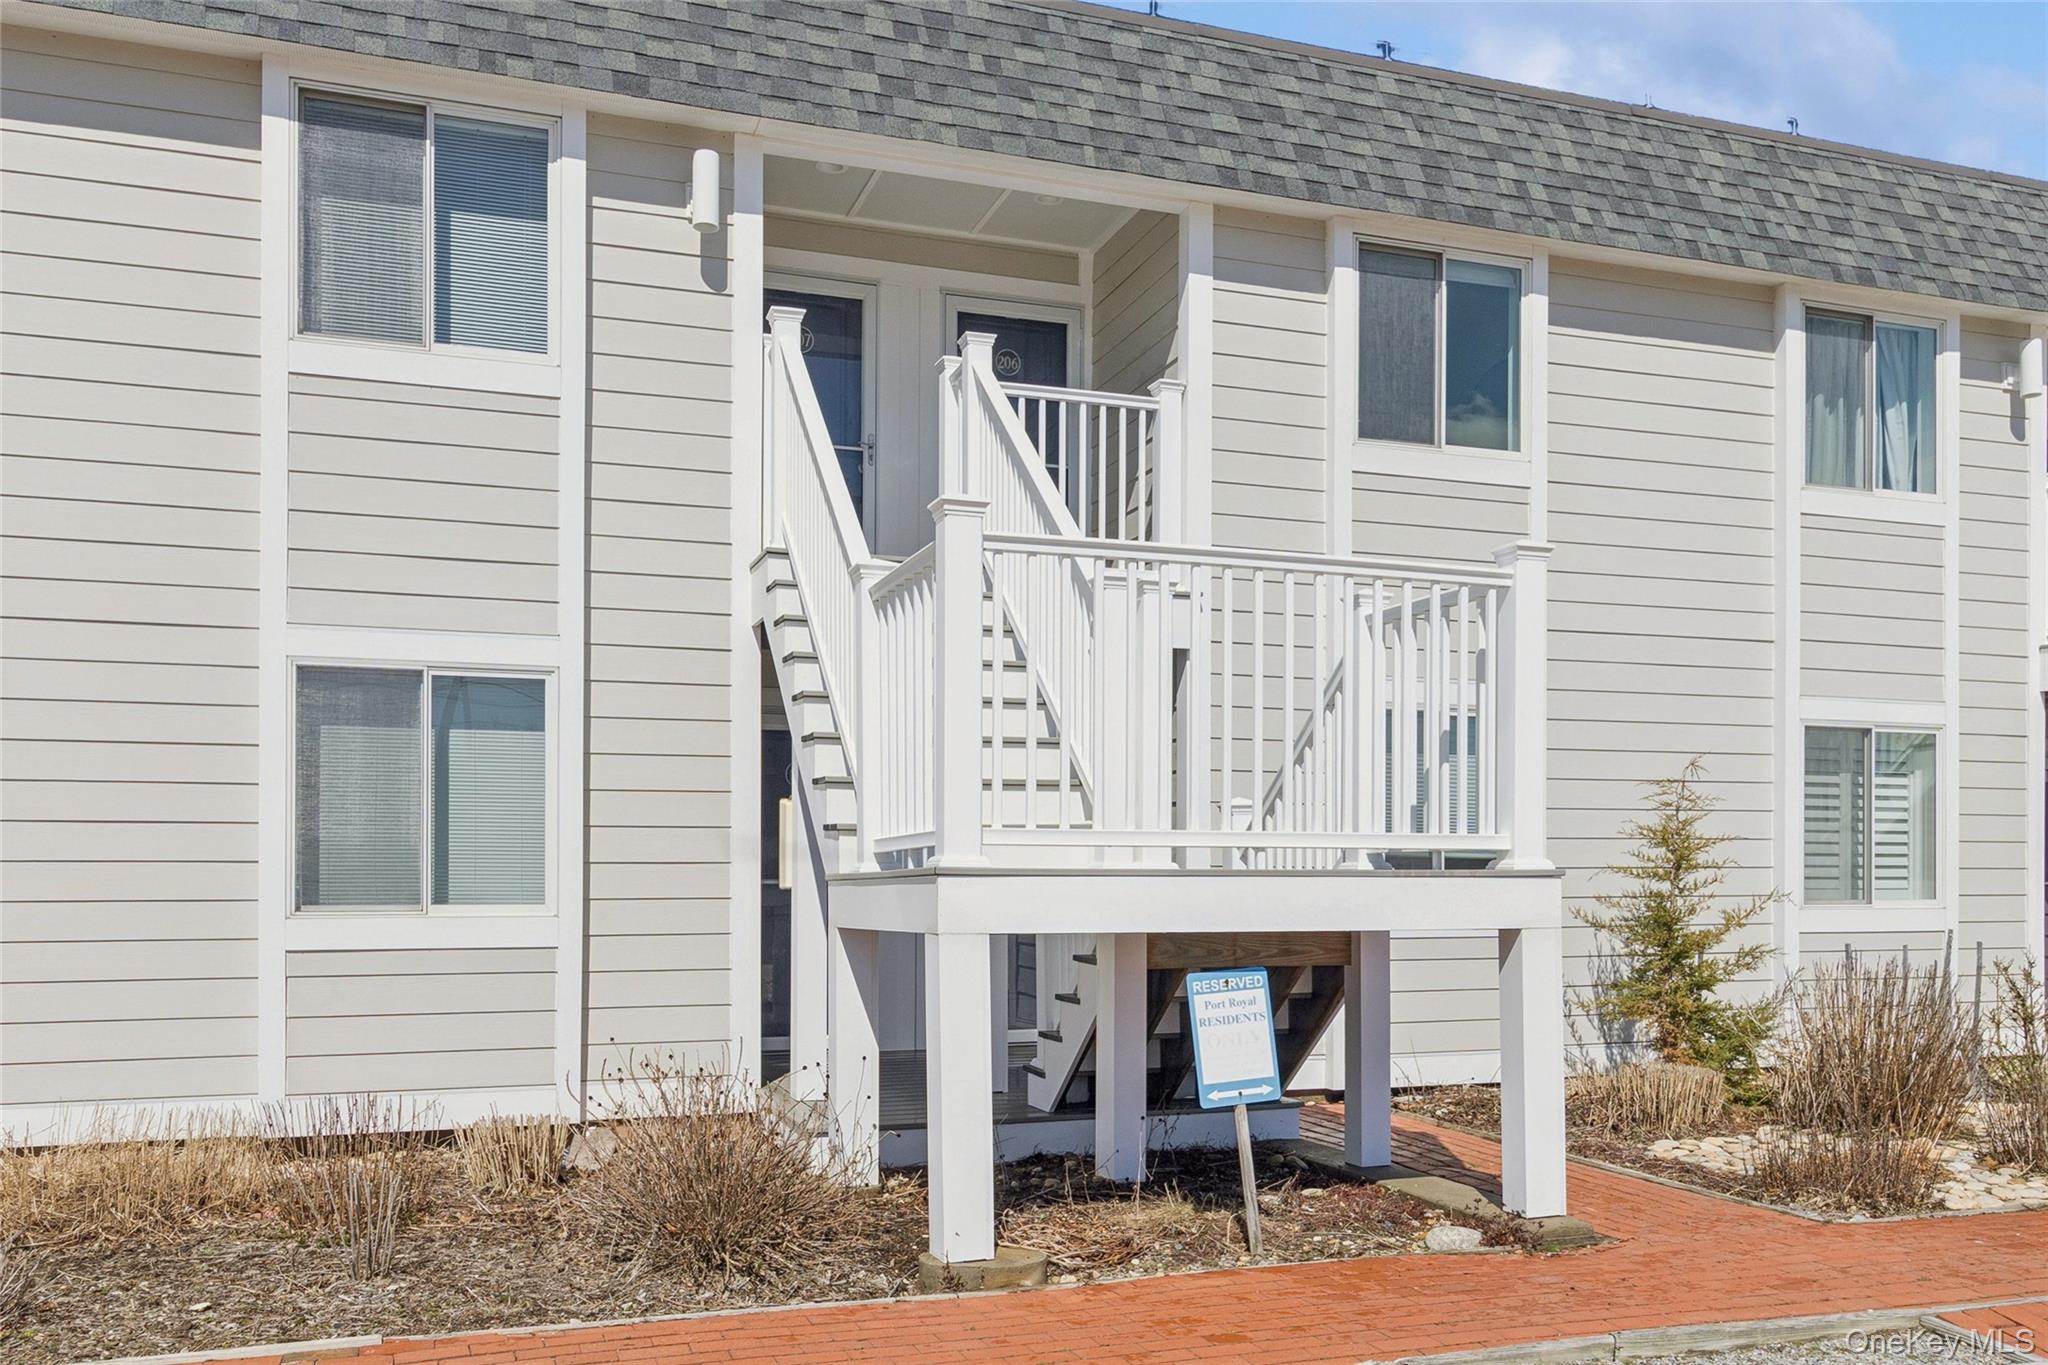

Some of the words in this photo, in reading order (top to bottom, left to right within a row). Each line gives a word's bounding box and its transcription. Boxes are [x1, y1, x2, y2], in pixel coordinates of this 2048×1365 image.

[998, 355, 1018, 370] 206
[1192, 975, 1263, 993] RESERVED
[1204, 1000, 1226, 1010] Port
[1228, 996, 1257, 1010] Royal
[1199, 1011, 1266, 1028] RESIDENTS
